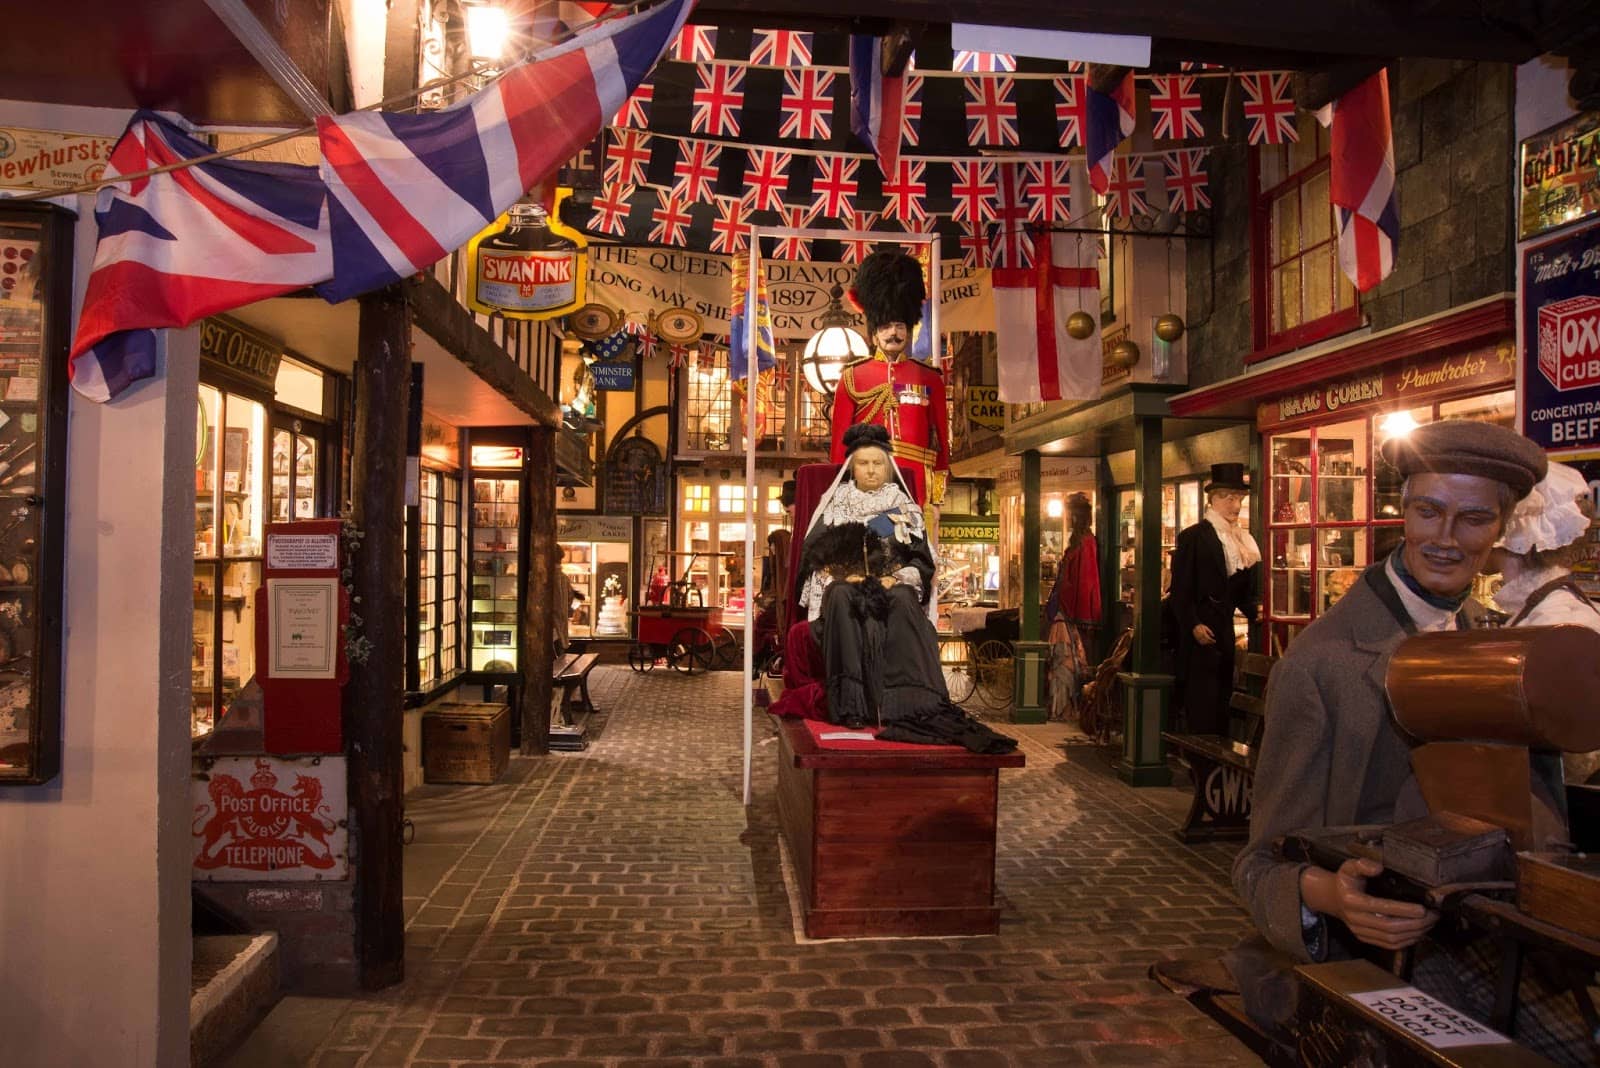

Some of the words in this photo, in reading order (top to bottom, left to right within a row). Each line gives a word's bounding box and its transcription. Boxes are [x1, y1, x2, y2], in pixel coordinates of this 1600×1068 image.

[0, 139, 113, 179] ewhurst's
[540, 261, 570, 282] INK
[595, 246, 637, 266] THE
[590, 268, 641, 292] LONG
[646, 285, 691, 308] MAY
[695, 301, 732, 321] SHE
[771, 289, 817, 306] 1897
[226, 332, 280, 376] OFFICE
[1562, 315, 1600, 358] OX
[1326, 376, 1384, 411] COHEN
[1396, 355, 1487, 392] Pawnbroker
[1551, 417, 1600, 442] BEEF
[221, 795, 256, 813] POST
[259, 794, 310, 813] OFFICE
[245, 815, 287, 838] PUBLIC
[225, 847, 305, 865] TELEPHONE
[1370, 1001, 1437, 1038] TOUCH
[1387, 996, 1418, 1012] DO
[1417, 1013, 1465, 1037] NOT
[1410, 996, 1487, 1035] PLEASE
